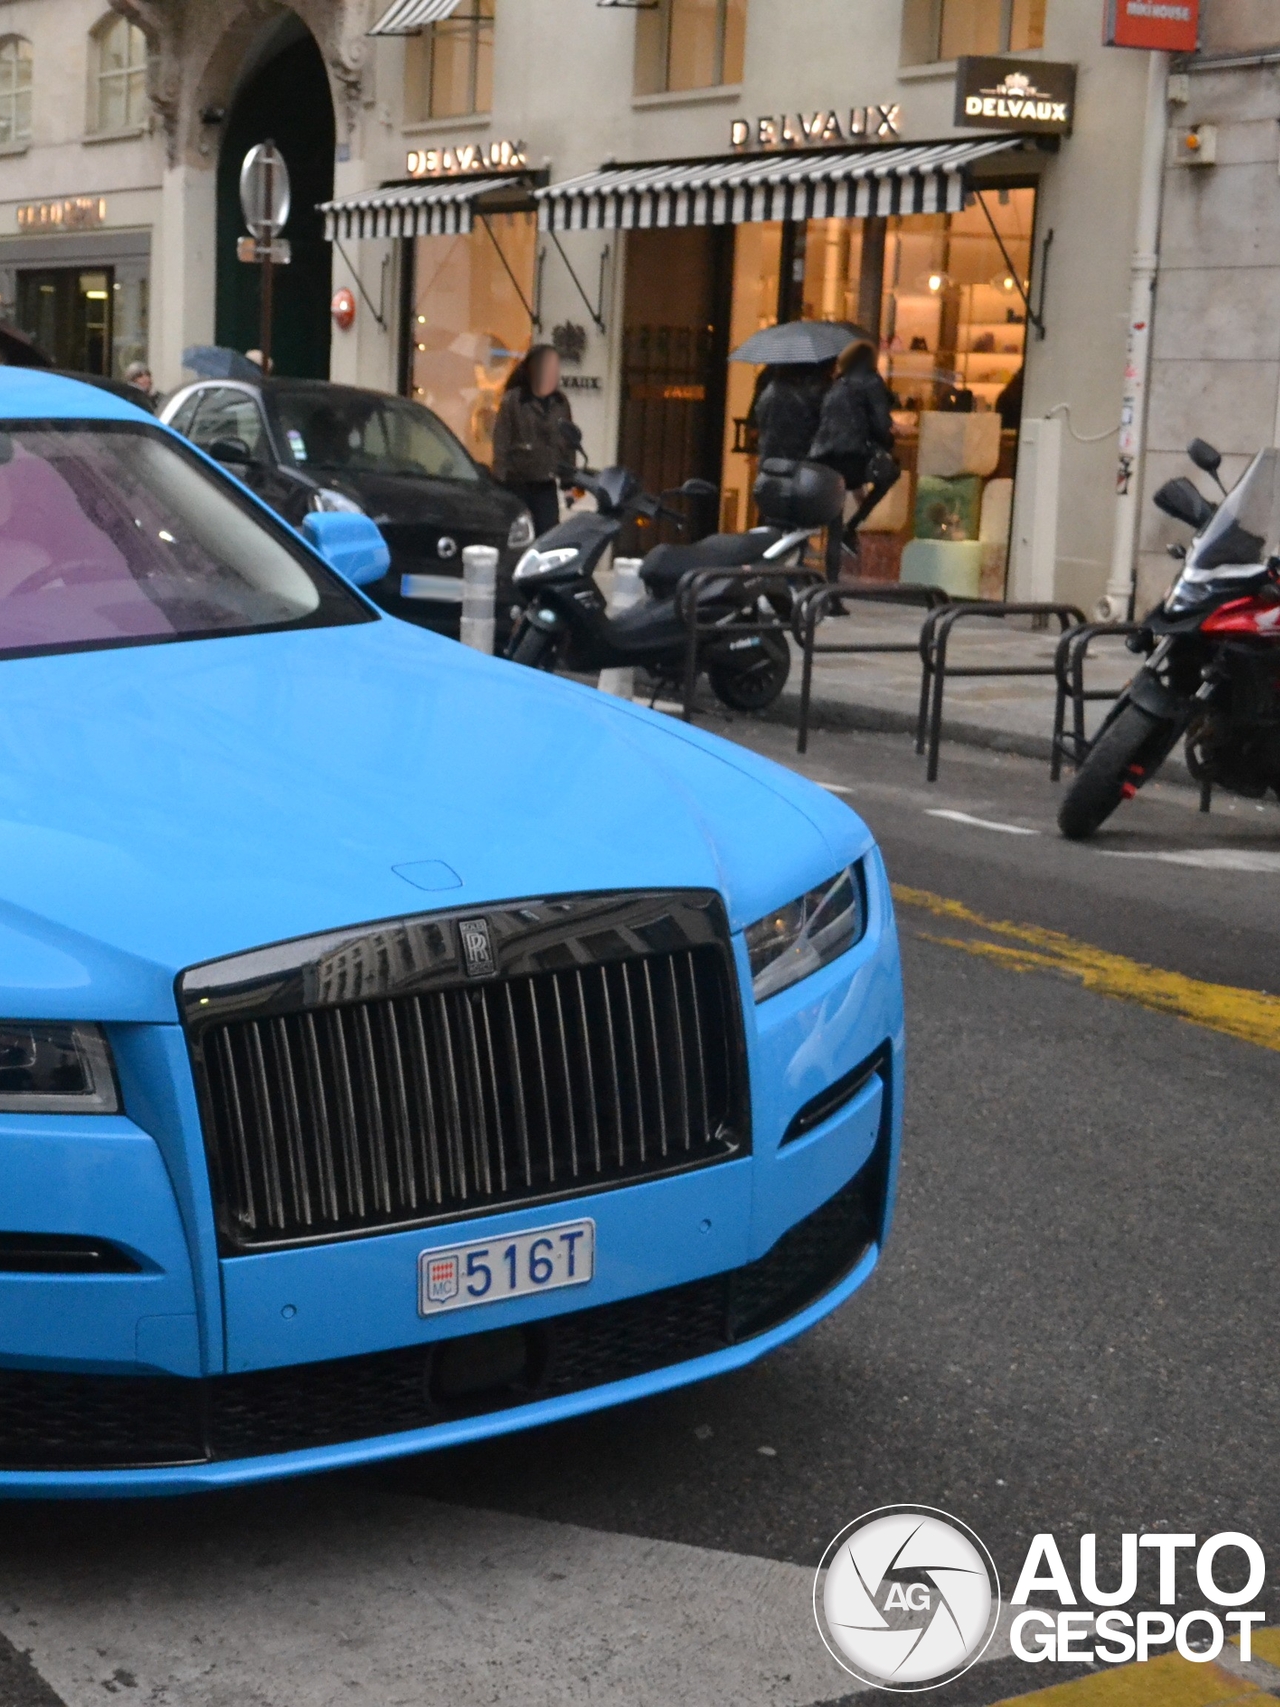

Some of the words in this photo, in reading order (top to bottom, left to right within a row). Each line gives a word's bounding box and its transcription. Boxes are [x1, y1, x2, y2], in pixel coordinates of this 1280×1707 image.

[965, 96, 1067, 121] DELVAUX
[731, 104, 900, 148] DELVAUX
[407, 139, 526, 175] DELVAUX
[561, 376, 600, 390] VAUX
[466, 1230, 584, 1297] 516T
[432, 1280, 452, 1296] MC
